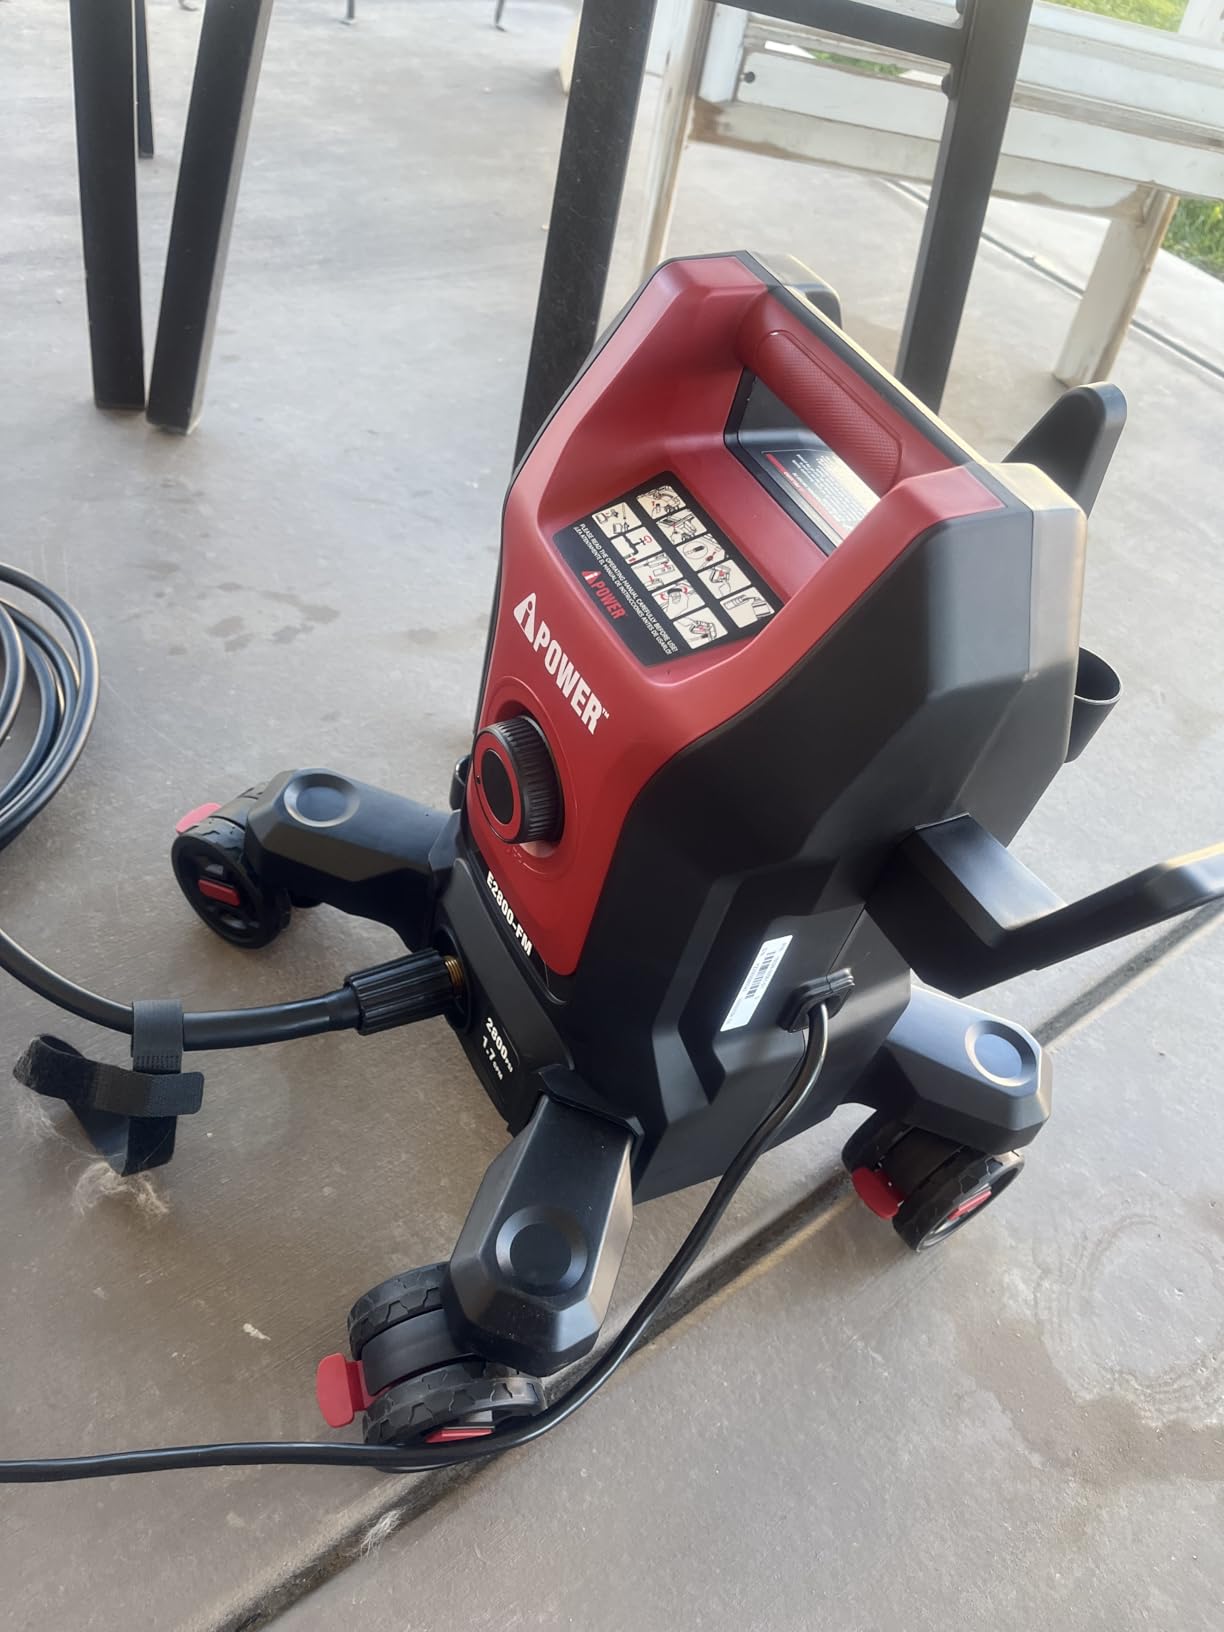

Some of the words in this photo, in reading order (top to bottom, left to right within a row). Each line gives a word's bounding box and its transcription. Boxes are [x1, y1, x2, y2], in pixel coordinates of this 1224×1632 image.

[580, 523, 594, 539] PLEASE
[591, 538, 602, 550] READ
[599, 549, 609, 559] THE
[605, 557, 626, 581] OPERATING
[622, 579, 639, 600] MANUAL
[636, 598, 657, 624] CAREFULLY
[654, 622, 671, 641] BEFORE
[580, 534, 602, 560] ATENTAMENTE
[602, 563, 617, 581] MANUAL
[619, 585, 645, 618] INSTRUCCIONES
[641, 616, 655, 631] ANTES
[486, 870, 533, 957] E2800-FM
[482, 1035, 496, 1061] 1.7
[485, 1017, 508, 1060] 2800
